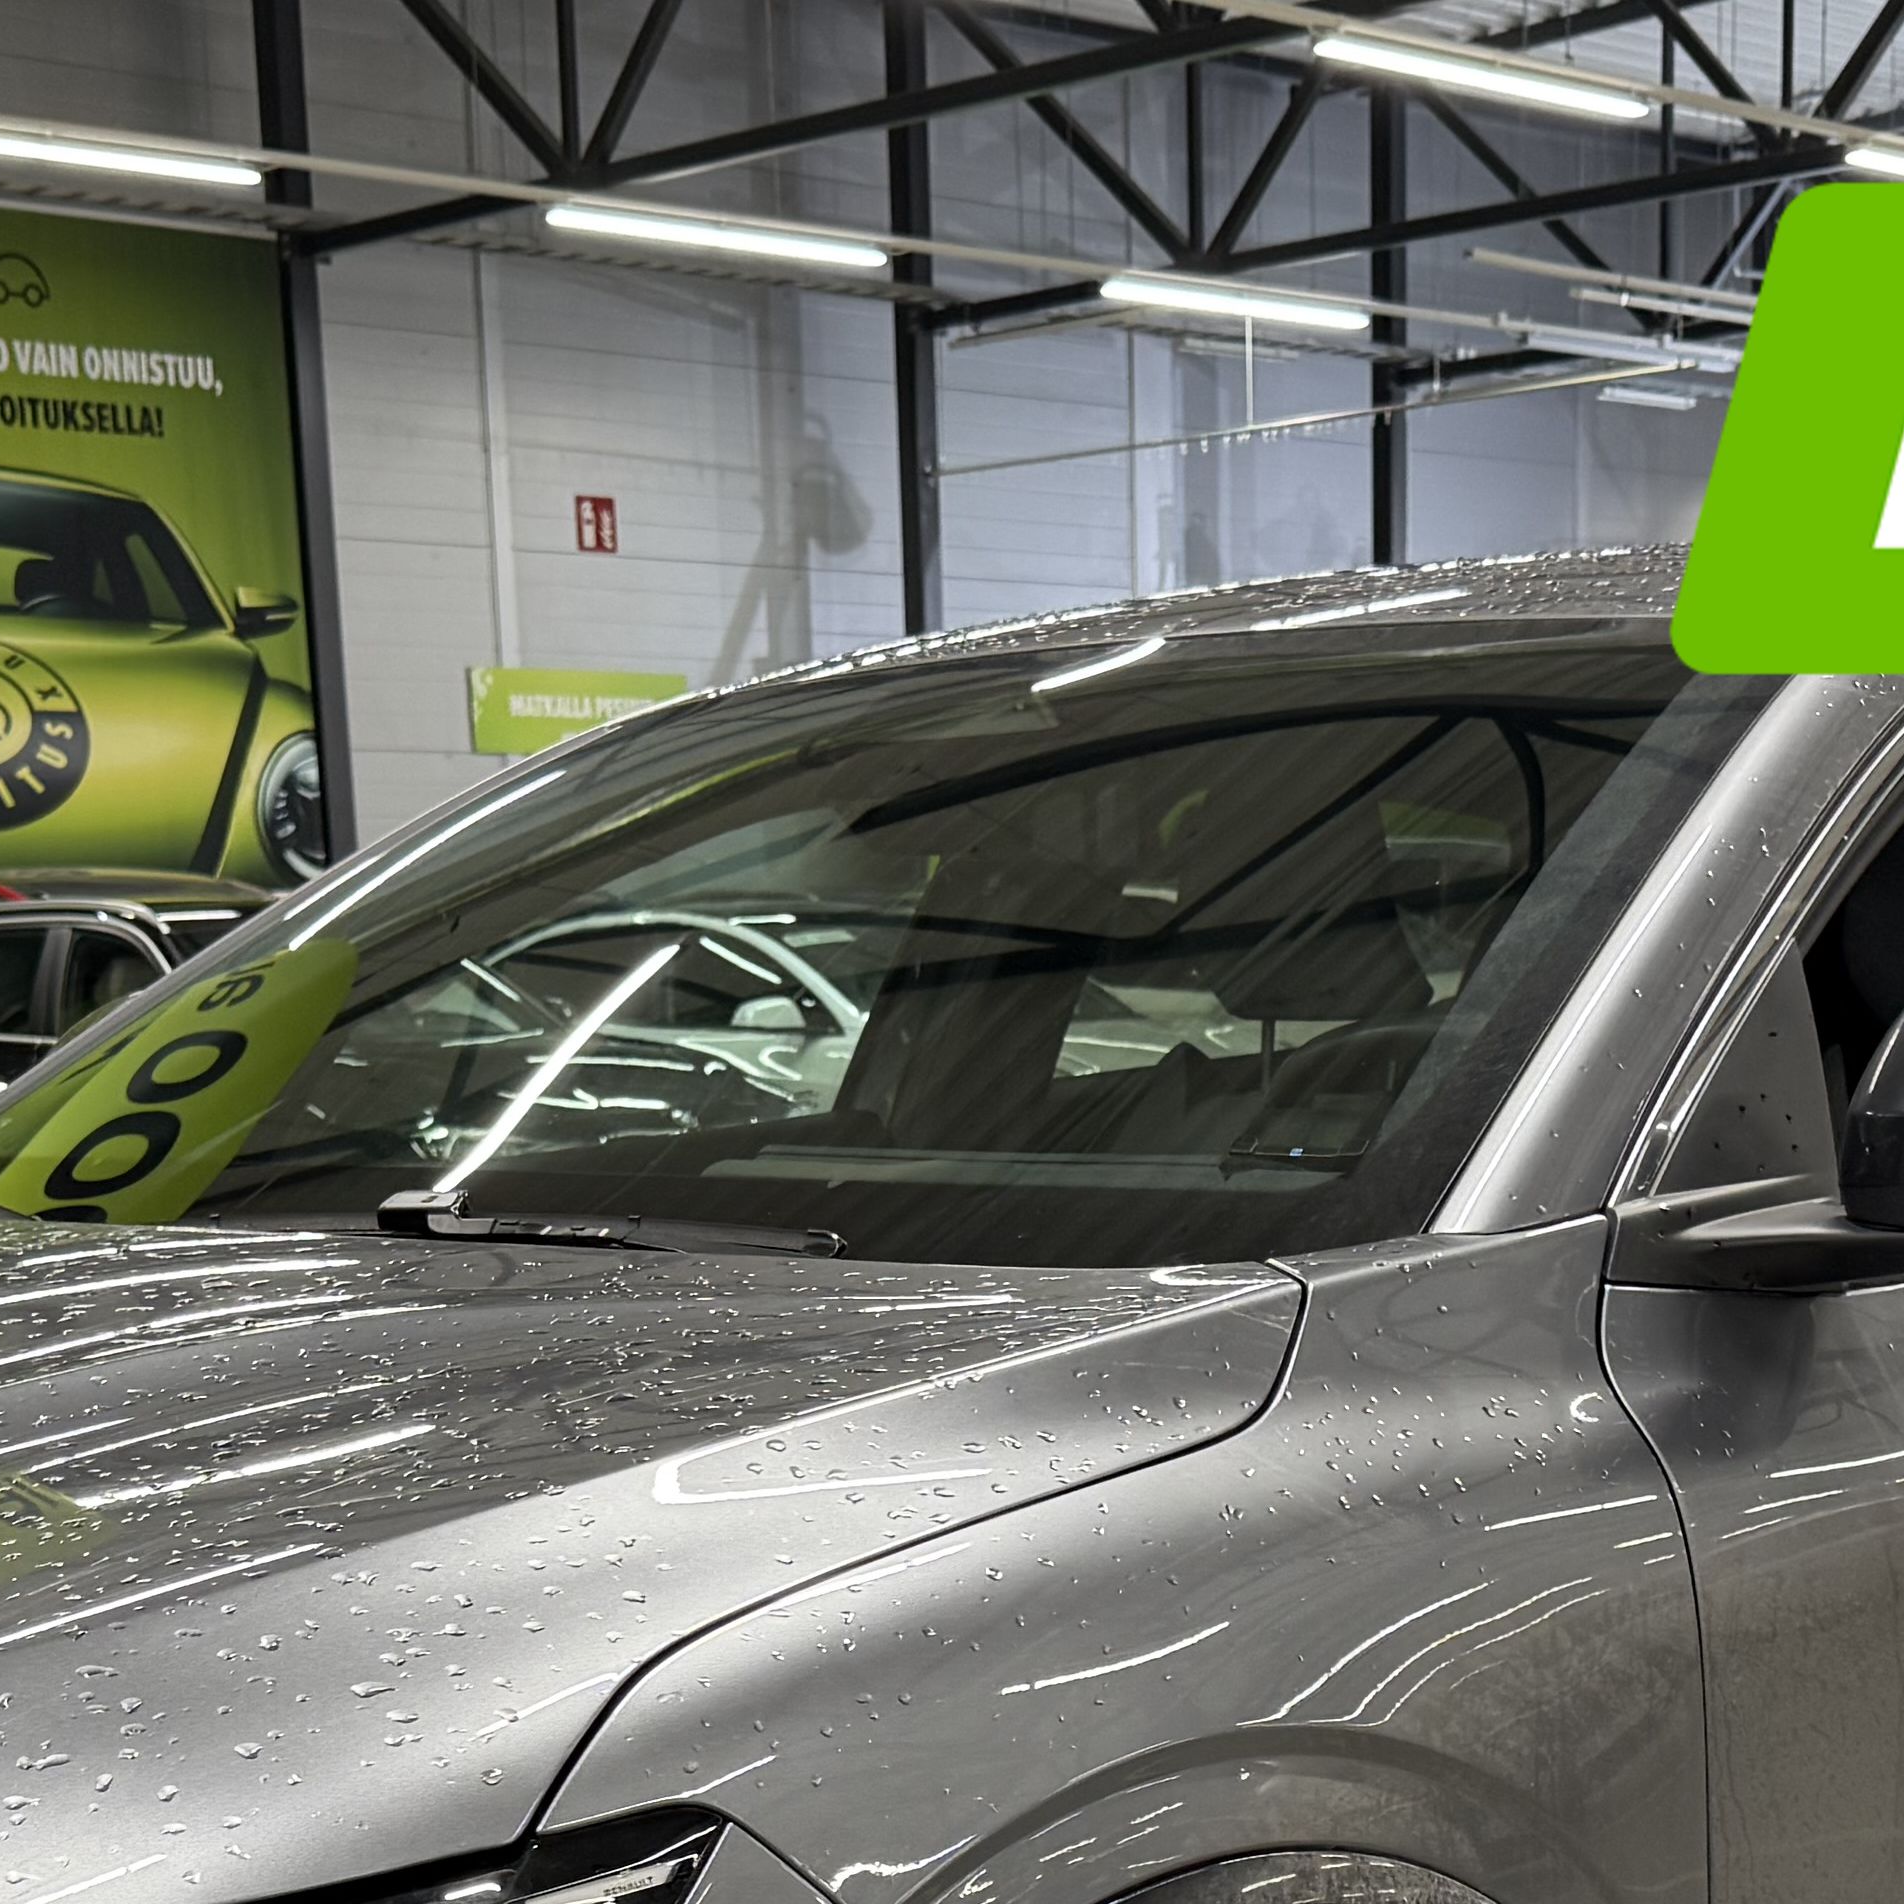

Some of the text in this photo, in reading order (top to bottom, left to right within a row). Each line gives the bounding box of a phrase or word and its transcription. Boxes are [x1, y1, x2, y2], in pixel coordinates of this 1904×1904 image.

[15, 344, 78, 379] VAIN
[83, 347, 223, 397] ONNISTUU,
[603, 1876, 654, 1897] RENAULT
